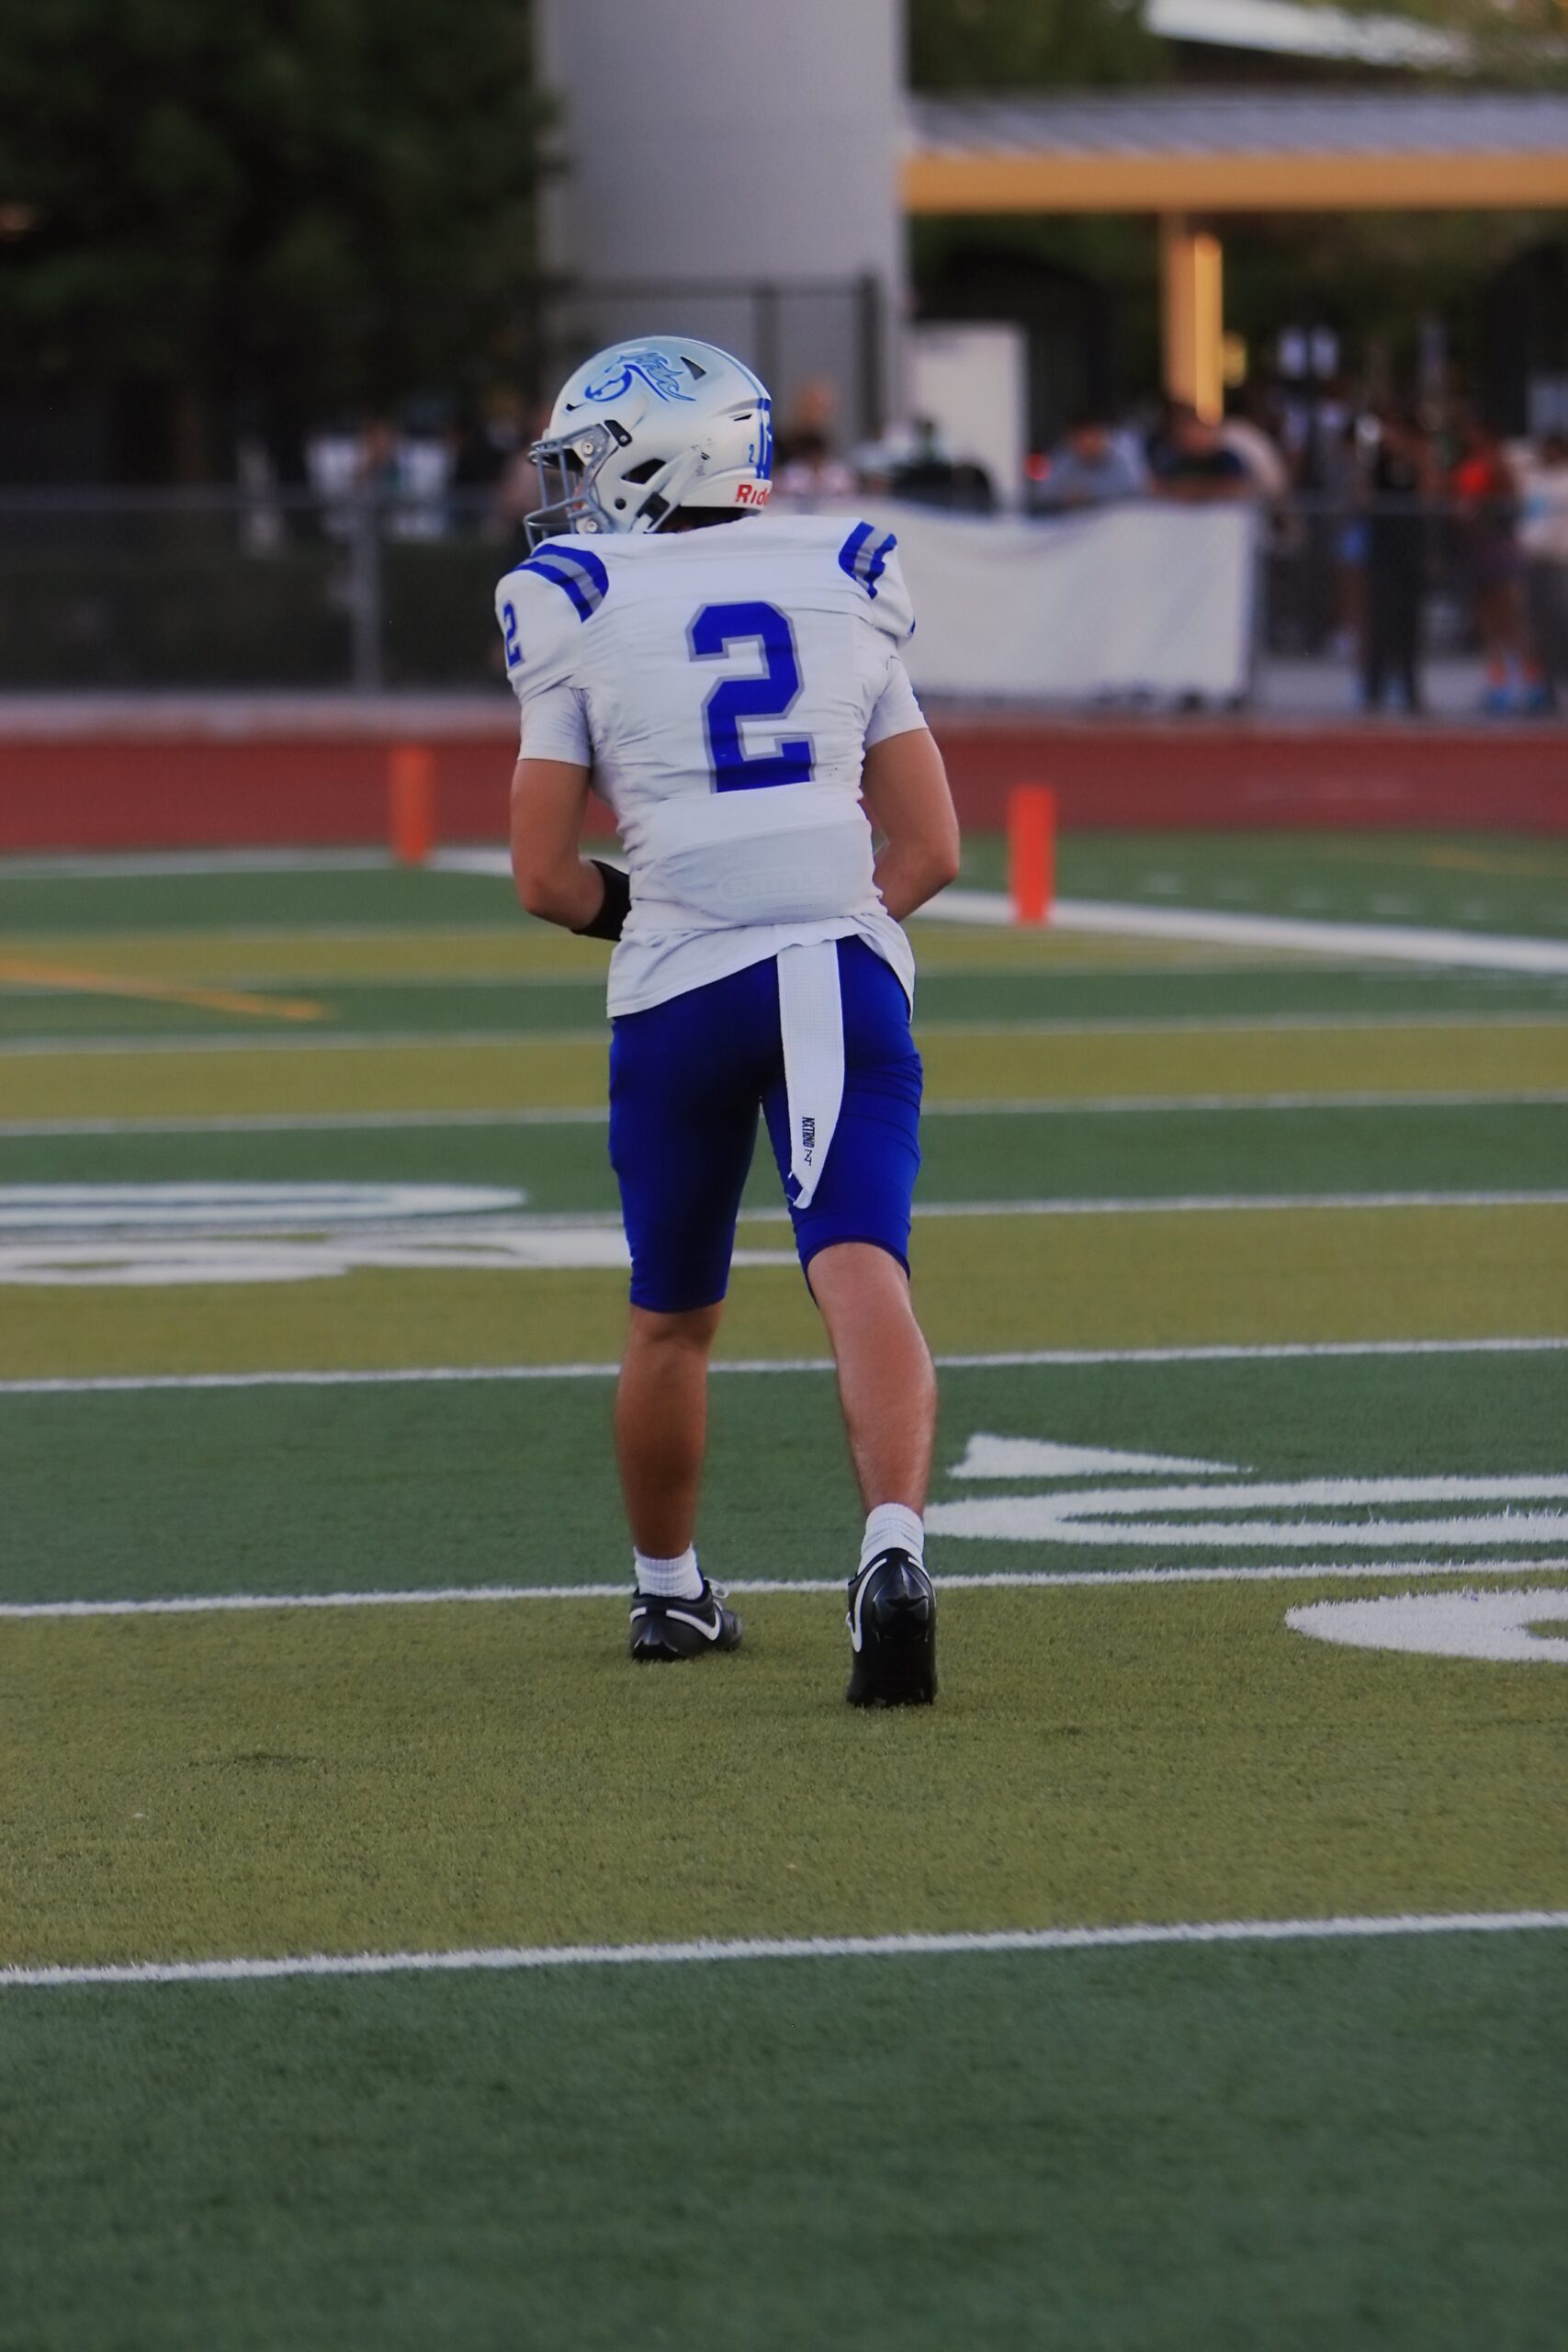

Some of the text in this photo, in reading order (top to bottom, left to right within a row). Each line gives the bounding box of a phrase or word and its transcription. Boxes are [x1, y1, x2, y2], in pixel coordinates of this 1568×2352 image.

[749, 444, 755, 463] 2
[502, 600, 525, 669] 2
[685, 600, 816, 793] 2
[802, 1117, 815, 1148] NXTRND
